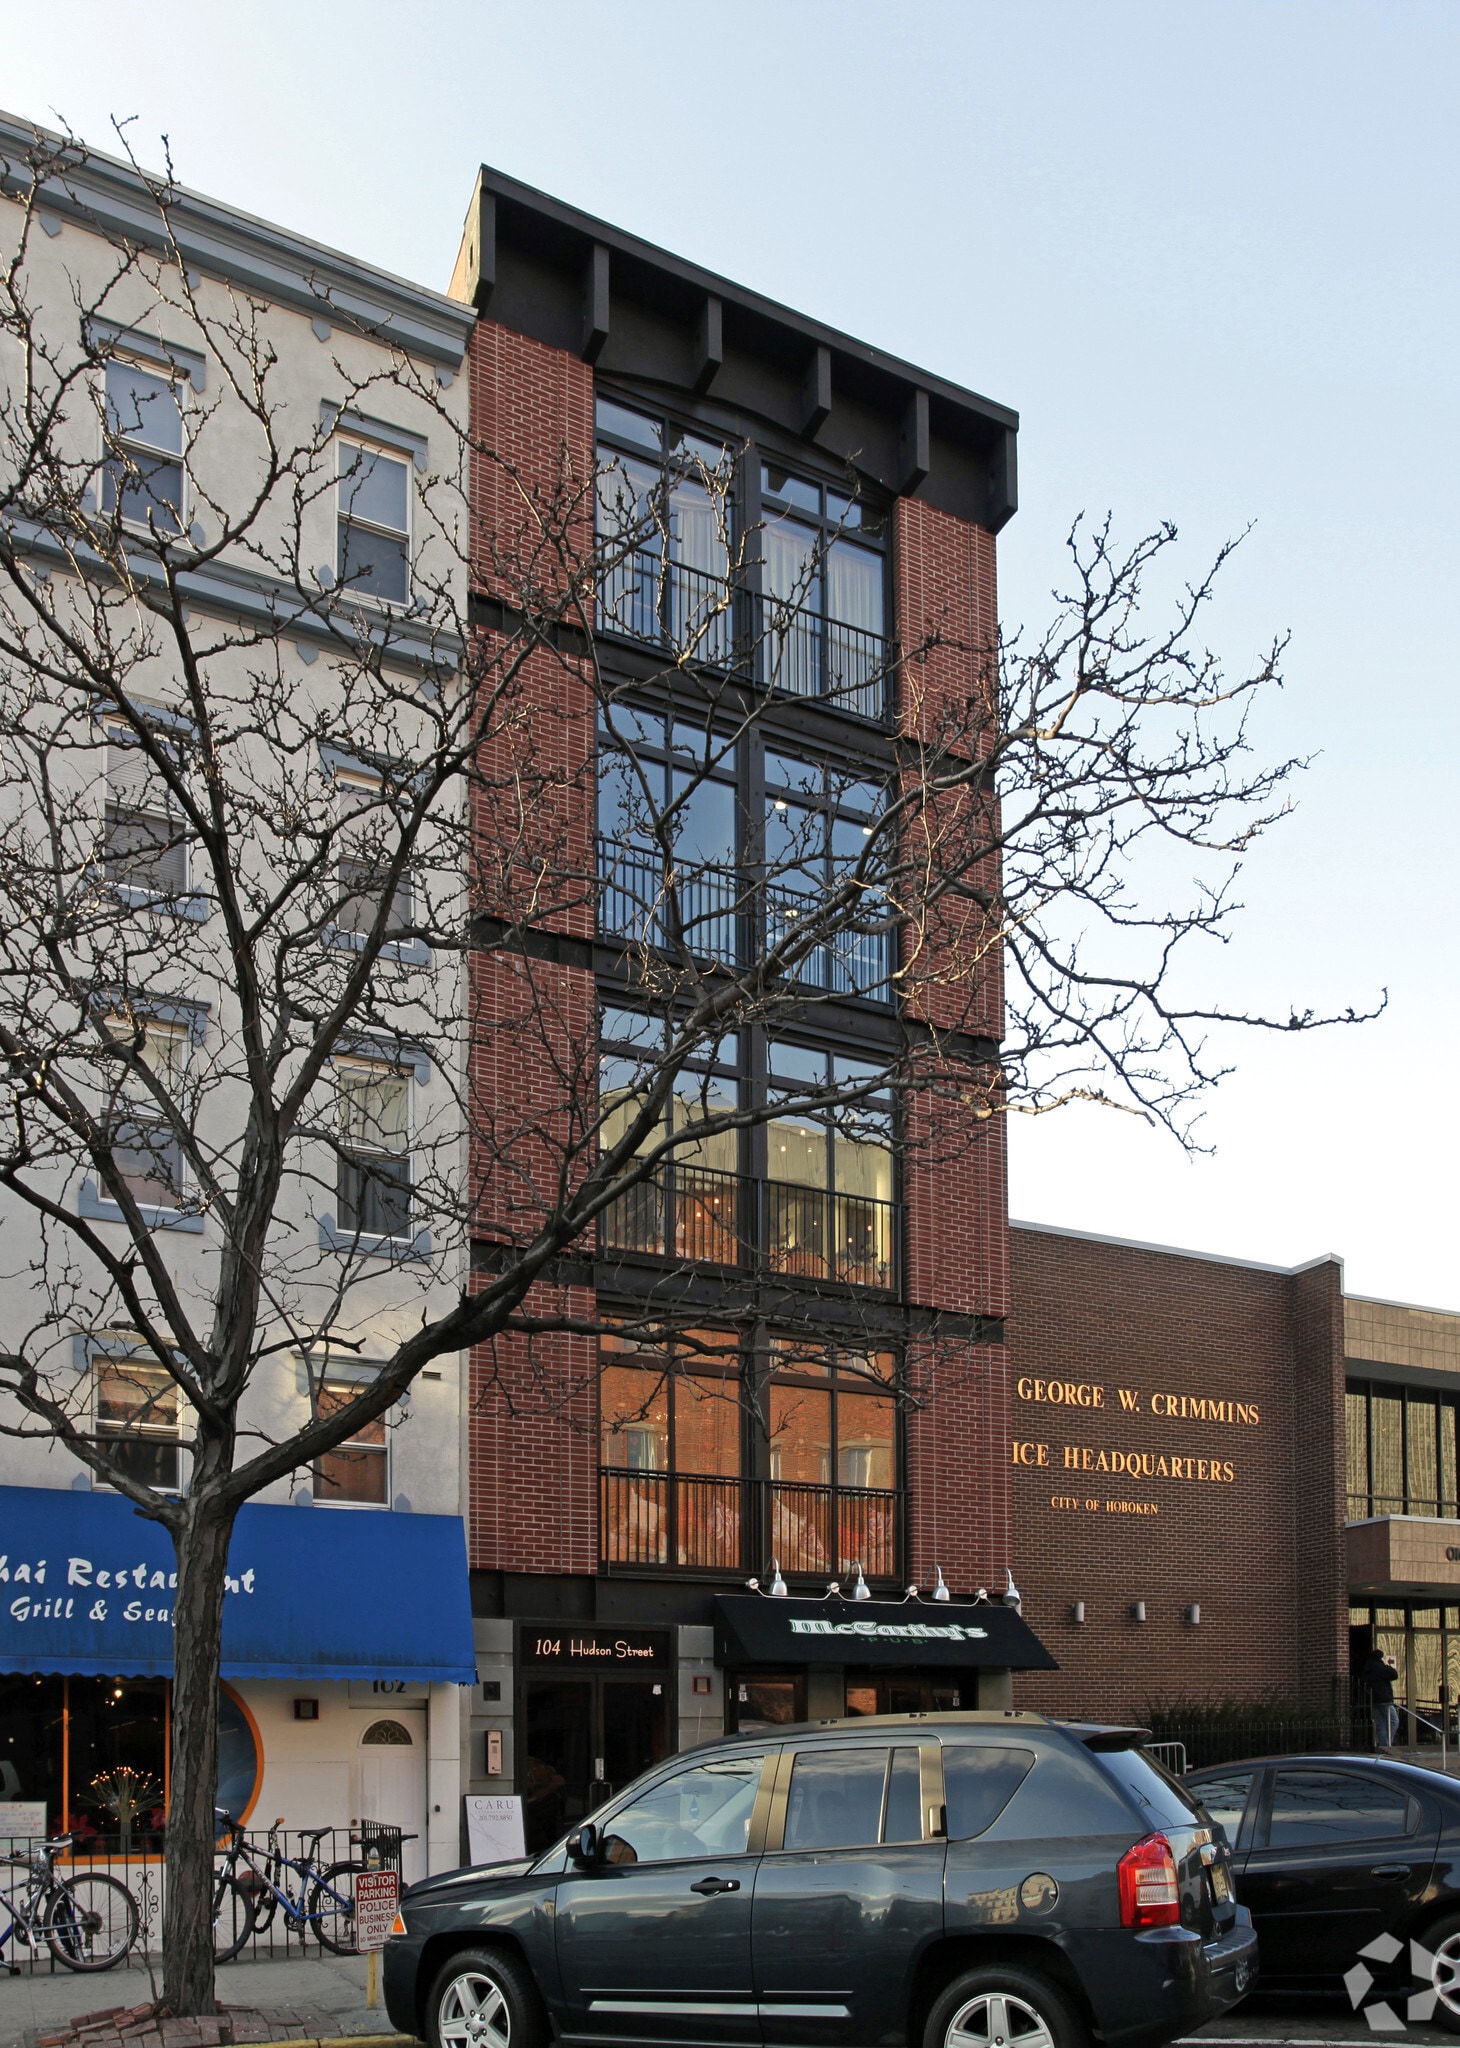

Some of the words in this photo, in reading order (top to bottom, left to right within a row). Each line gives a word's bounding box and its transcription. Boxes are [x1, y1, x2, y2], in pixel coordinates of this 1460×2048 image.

[1017, 1377, 1105, 1408] GEORGE
[1118, 1389, 1140, 1412] W.
[1151, 1393, 1260, 1425] CRIMMINS
[1063, 1446, 1235, 1482] HEADQUARTERS
[1051, 1496, 1079, 1510] CITY
[1085, 1498, 1100, 1511] OF
[1106, 1500, 1158, 1515] HOBOKEN
[67, 1557, 255, 1594] Restaunt
[10, 1596, 74, 1622] Grill
[89, 1600, 108, 1622] &
[789, 1618, 988, 1641] McCarthy's
[535, 1639, 561, 1655] 104
[570, 1639, 612, 1657] Hudson
[614, 1640, 654, 1658] Street
[373, 1679, 406, 1693] 102
[474, 1799, 514, 1810] CARU
[358, 1875, 395, 1888] VISITOR
[358, 1886, 396, 1900] PARKING
[360, 1900, 395, 1913] POLICE
[360, 1912, 395, 1924] BUSINESS
[366, 1923, 389, 1935] ONLY
[367, 1934, 382, 1942] MINUTE
